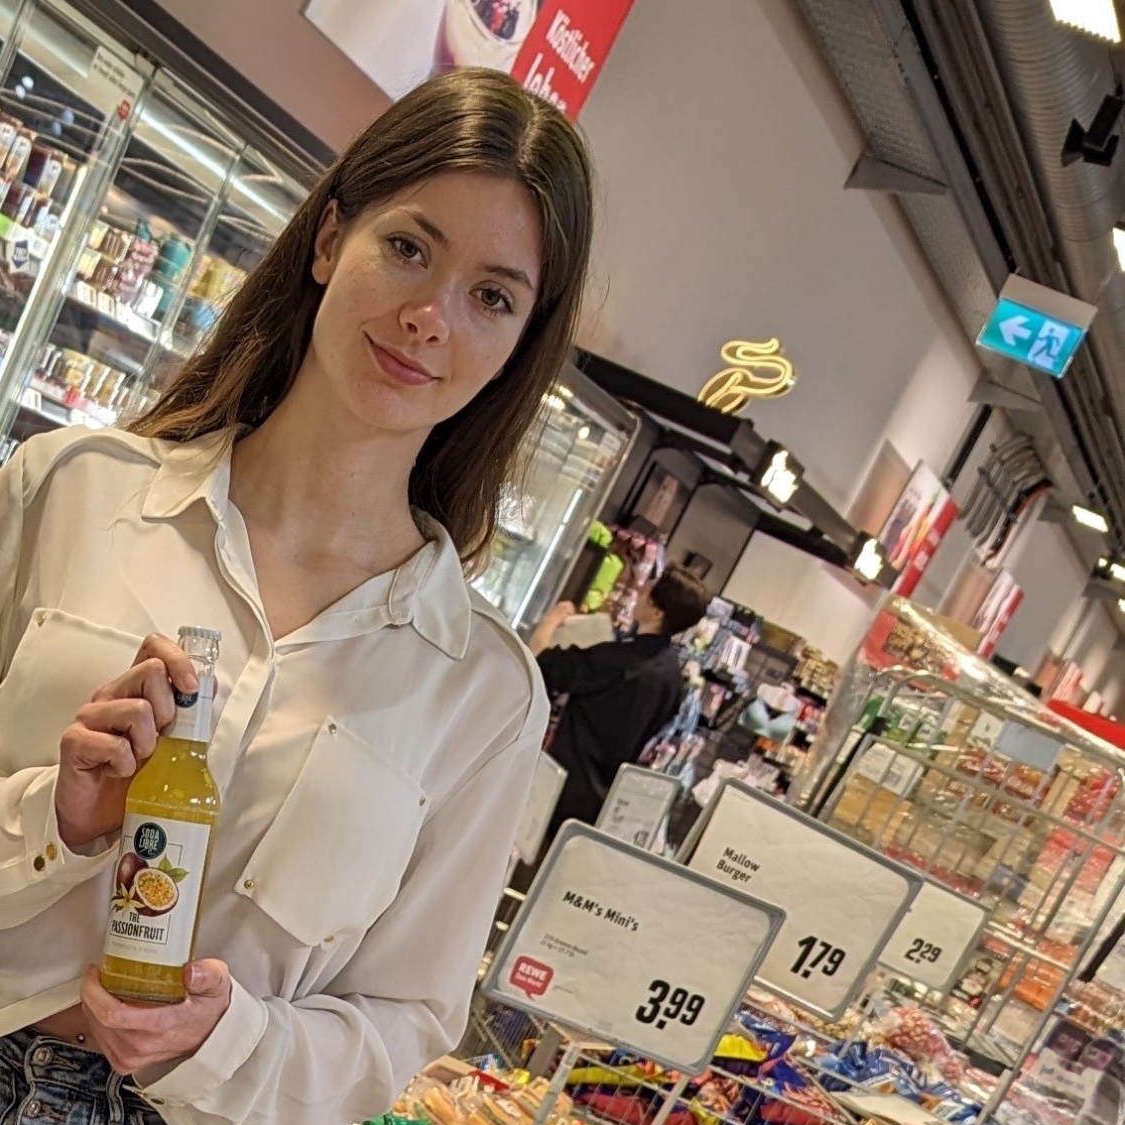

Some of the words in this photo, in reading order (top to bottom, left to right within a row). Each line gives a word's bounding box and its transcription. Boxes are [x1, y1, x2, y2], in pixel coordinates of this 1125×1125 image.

[139, 837, 158, 851] LIBRE
[141, 827, 160, 840] SODA
[716, 859, 751, 883] Burger
[723, 847, 760, 872] Mallow
[129, 911, 140, 923] THE
[562, 891, 603, 917] M&M's
[603, 908, 639, 932] Mini's
[111, 919, 165, 941] PASSIONFRUIT
[790, 935, 846, 979] 1.79
[904, 938, 943, 964] 2.29
[518, 962, 549, 981] REWE
[635, 979, 706, 1031] 3.99
